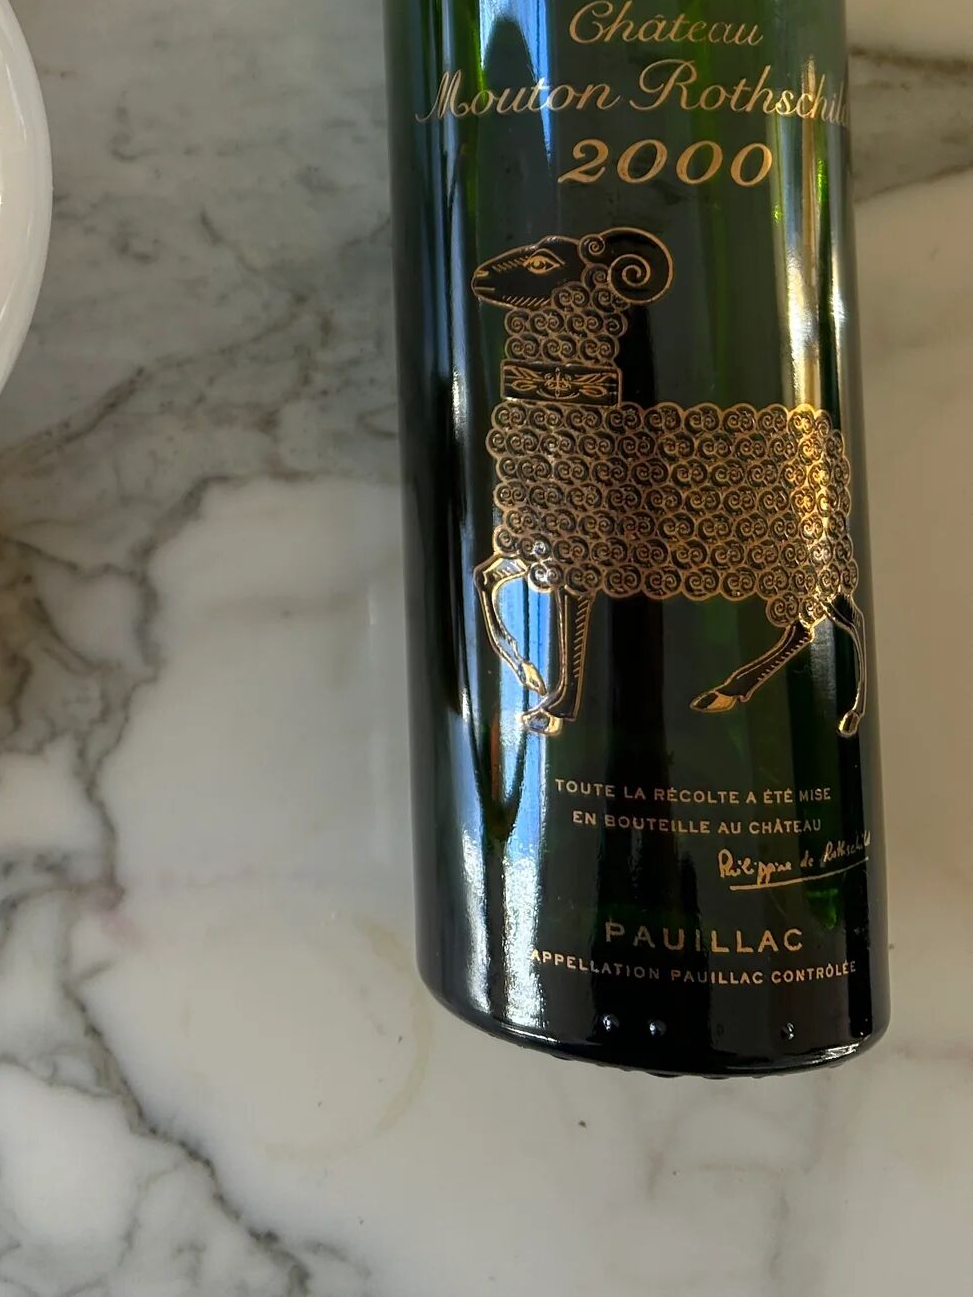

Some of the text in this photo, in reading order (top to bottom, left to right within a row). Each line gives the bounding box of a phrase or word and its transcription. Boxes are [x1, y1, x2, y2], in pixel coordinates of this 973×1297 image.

[568, 0, 763, 45] Château
[415, 68, 620, 122] Mouton
[558, 138, 773, 187] 2000
[554, 778, 831, 804] TOUTE LA RÉCOLTE A ÉTÉ MISE
[572, 810, 821, 834] EN BOUTEILLE AU CHÂTEAU
[800, 850, 814, 868] de
[605, 921, 803, 954] PAUILLAC
[530, 949, 857, 985] APPELLATION PAUILLAC CONTRÔLÉE
